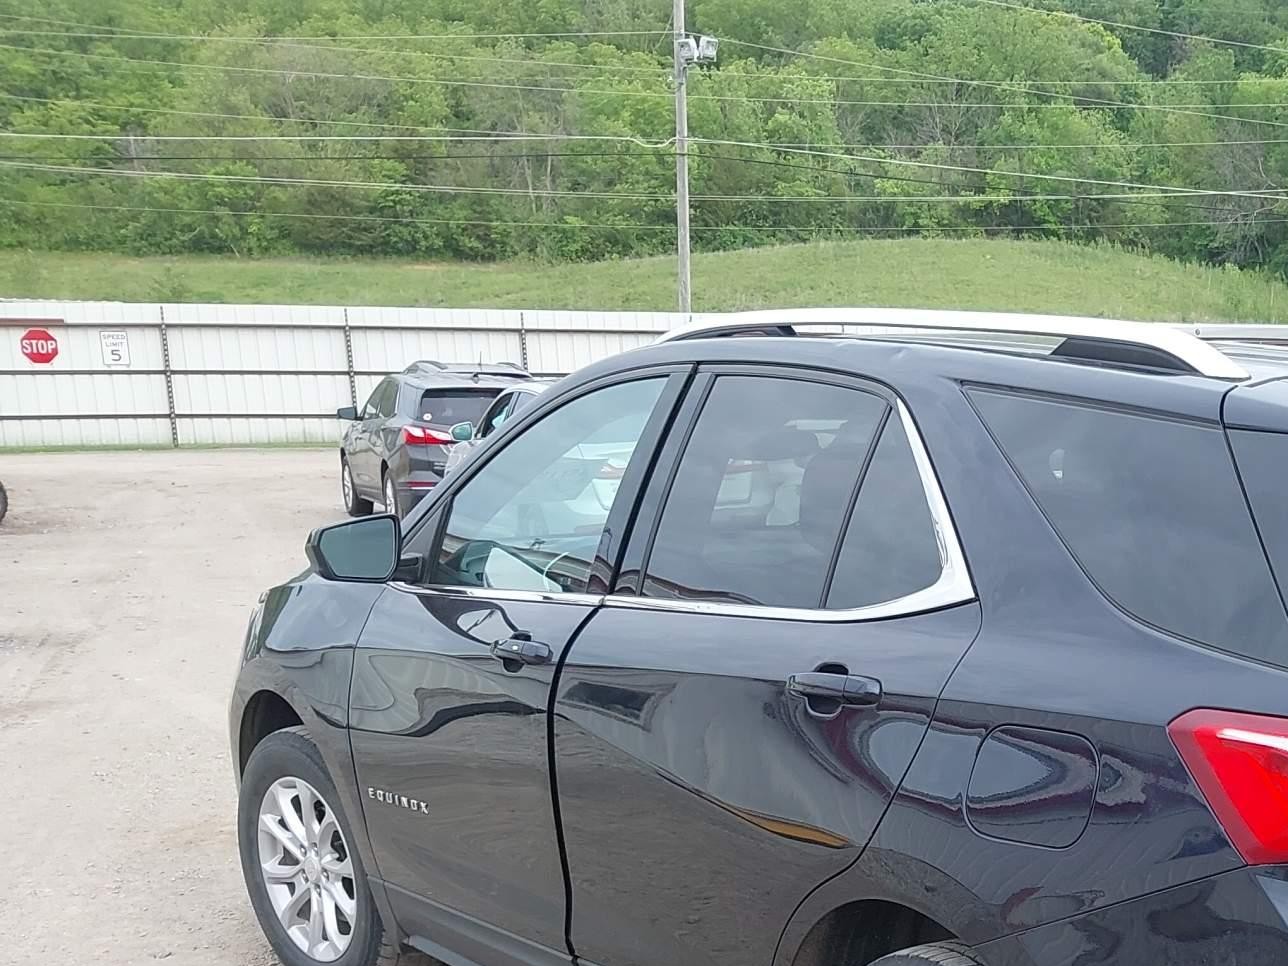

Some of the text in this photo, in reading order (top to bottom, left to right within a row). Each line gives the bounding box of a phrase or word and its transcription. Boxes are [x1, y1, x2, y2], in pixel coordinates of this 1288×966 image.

[22, 340, 56, 353] STOP
[111, 349, 122, 361] 5
[367, 787, 429, 814] EQUINOX
